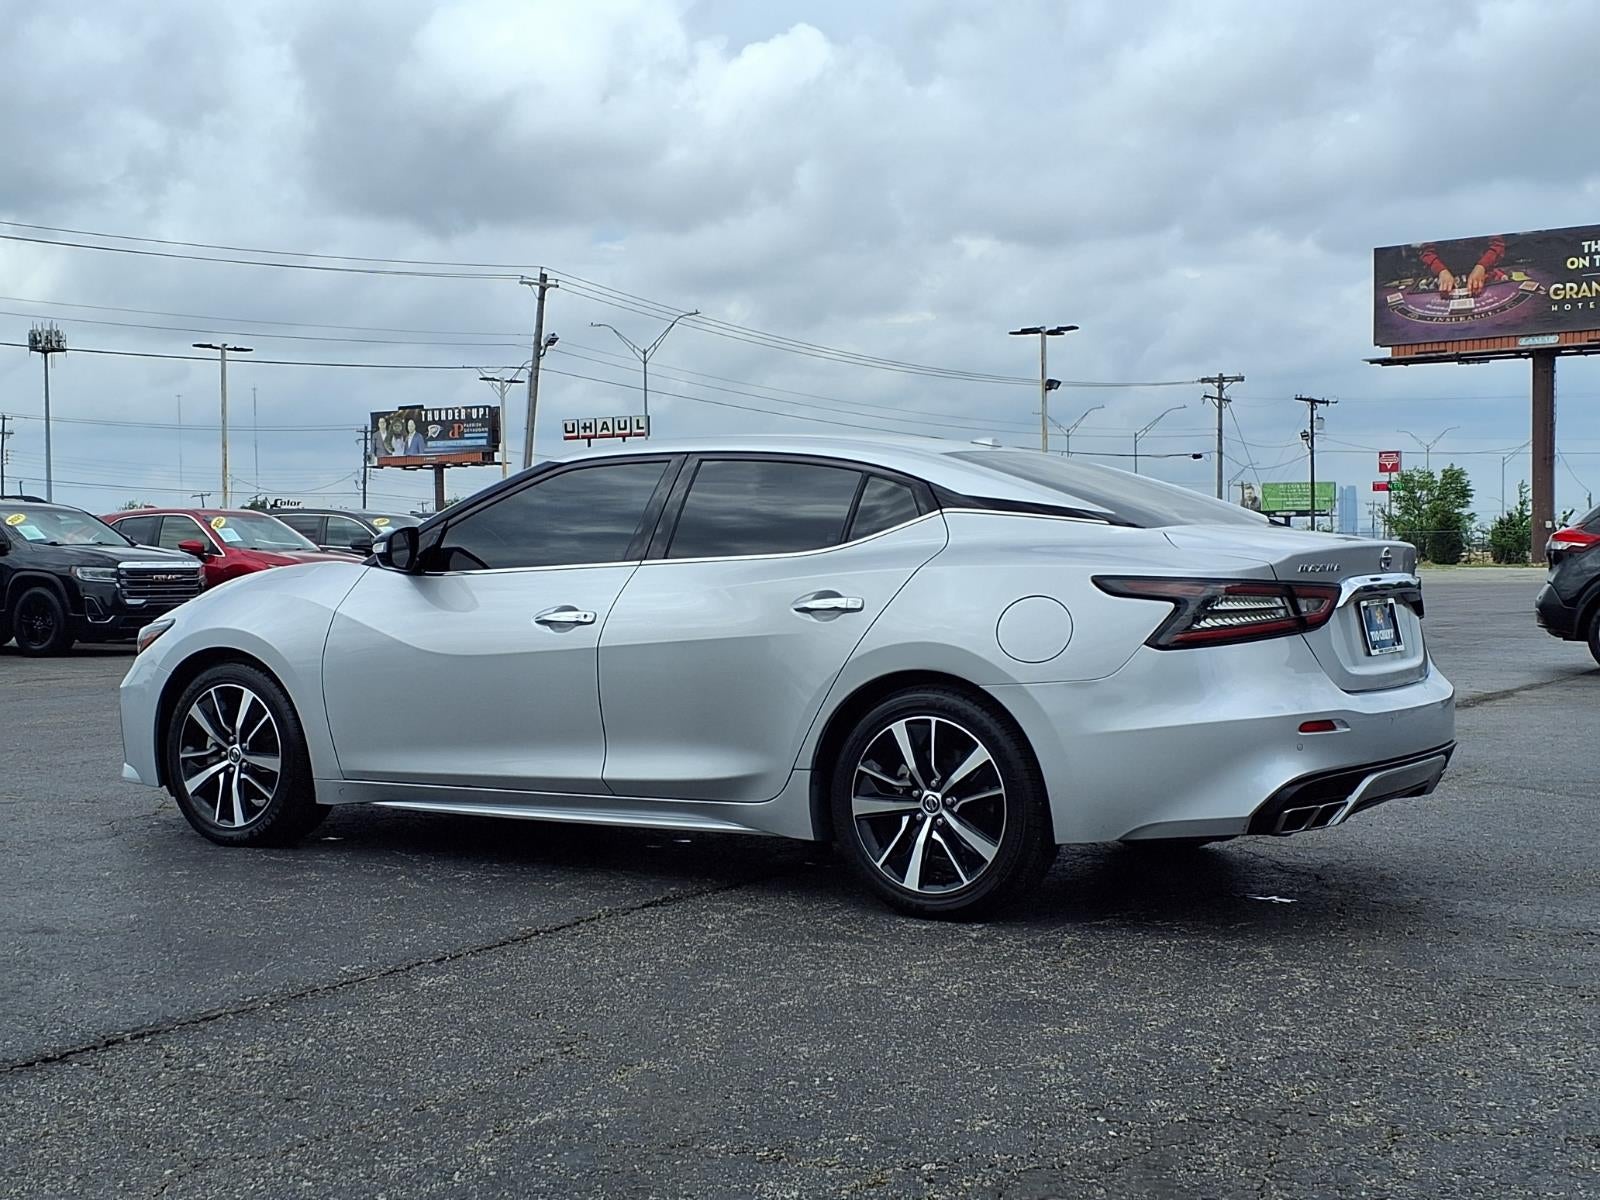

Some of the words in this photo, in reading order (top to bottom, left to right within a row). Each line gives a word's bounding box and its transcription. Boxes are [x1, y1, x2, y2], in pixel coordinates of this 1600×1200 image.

[1566, 256, 1589, 269] ON
[421, 408, 466, 422] THUNDER
[471, 407, 489, 420] UP!
[271, 498, 302, 509] Color
